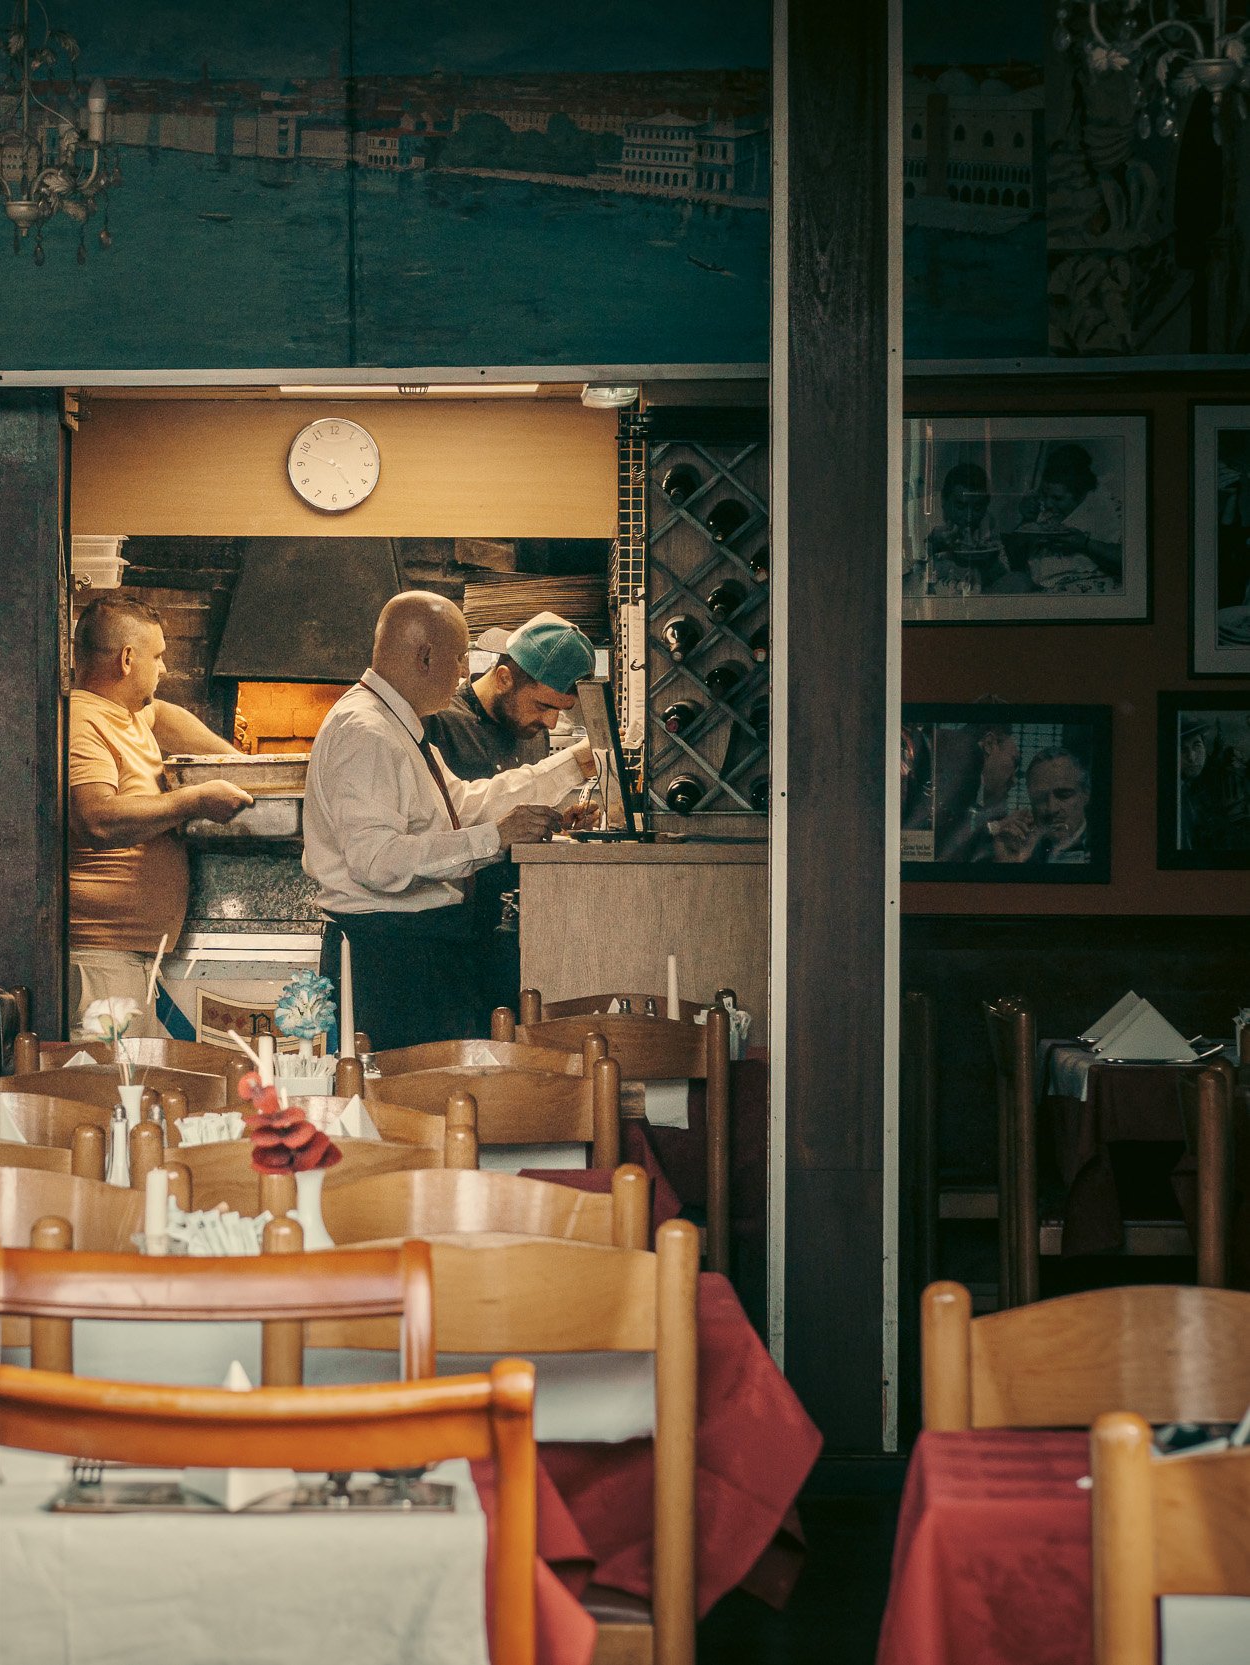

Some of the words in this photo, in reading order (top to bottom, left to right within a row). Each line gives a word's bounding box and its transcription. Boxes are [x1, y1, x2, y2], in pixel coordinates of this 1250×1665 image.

[312, 430, 323, 441] 11
[330, 426, 340, 436] 12
[300, 442, 311, 453] 10
[360, 444, 369, 452] 2
[314, 490, 322, 498] 7
[332, 494, 338, 503] 6
[348, 489, 355, 499] 5
